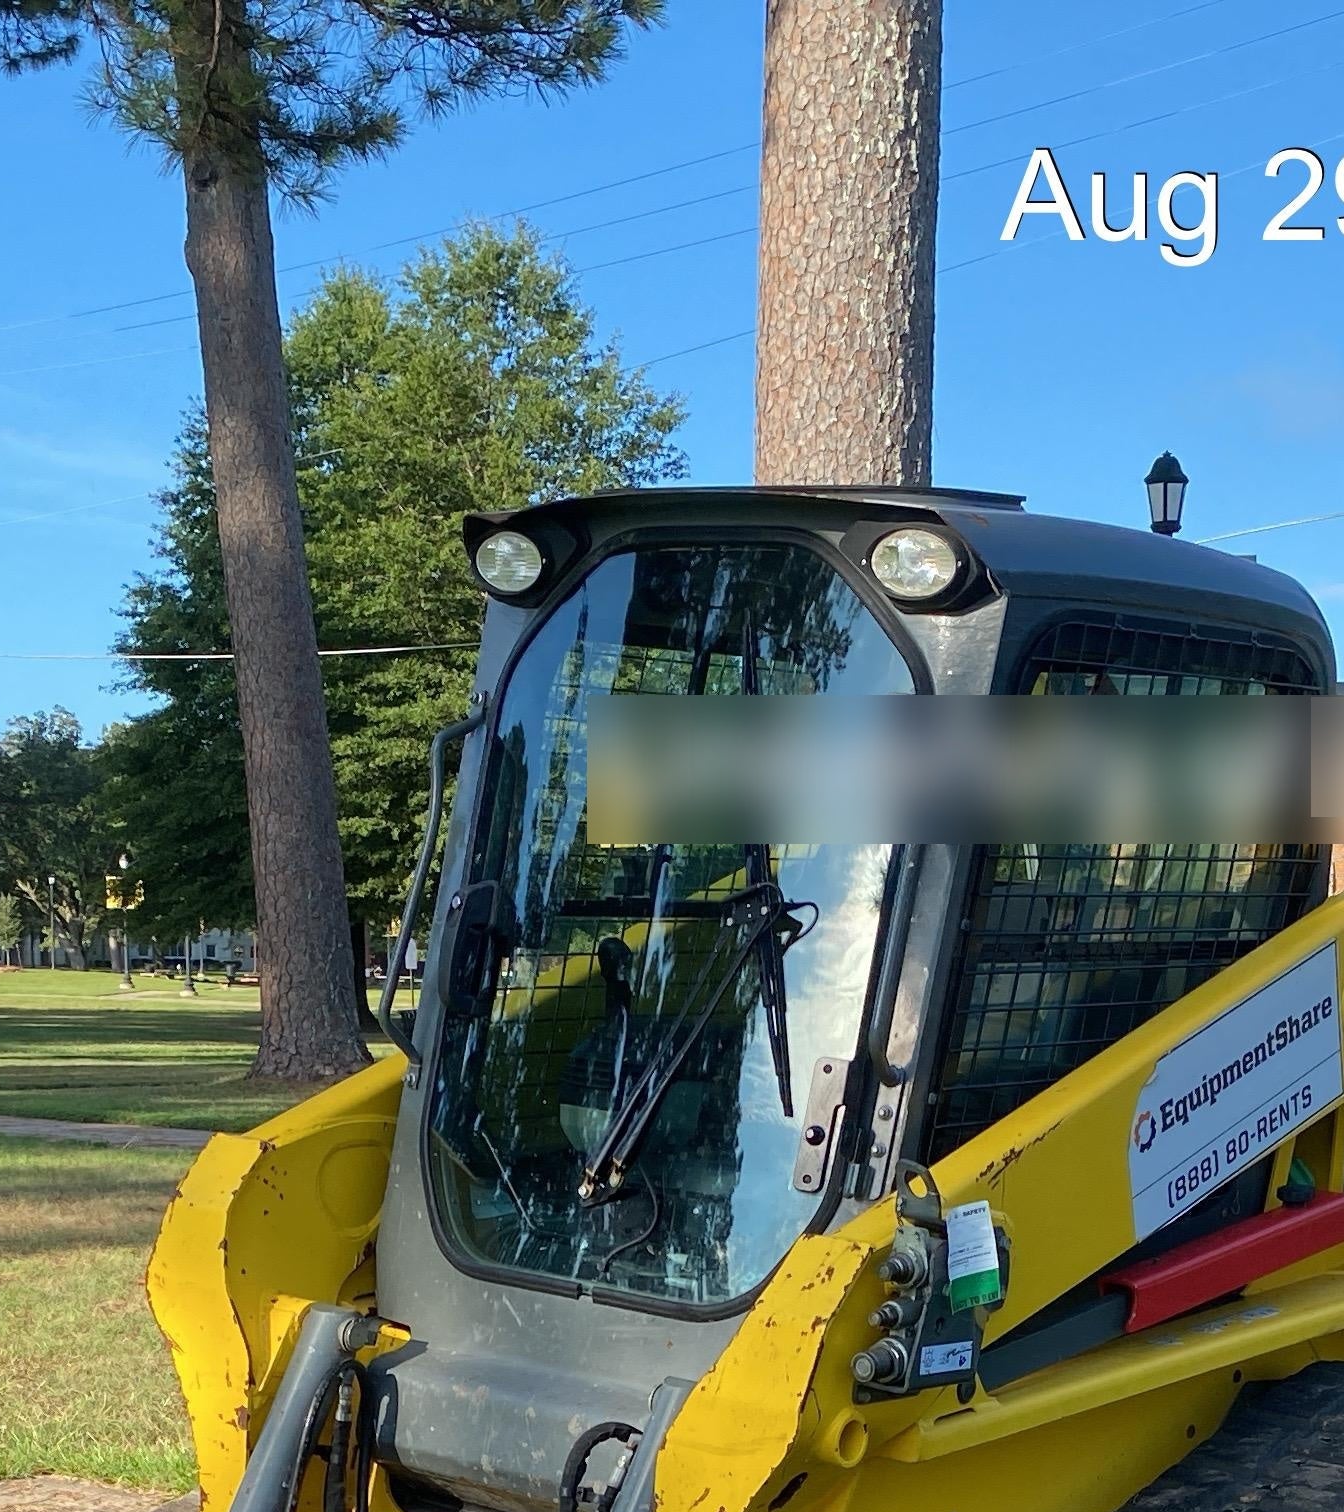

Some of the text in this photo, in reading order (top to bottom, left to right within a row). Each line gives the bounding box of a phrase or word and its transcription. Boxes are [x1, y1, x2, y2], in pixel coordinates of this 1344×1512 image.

[1159, 996, 1333, 1132] EquipmentShare
[1167, 1085, 1312, 1208] (888) 80-RENTS
